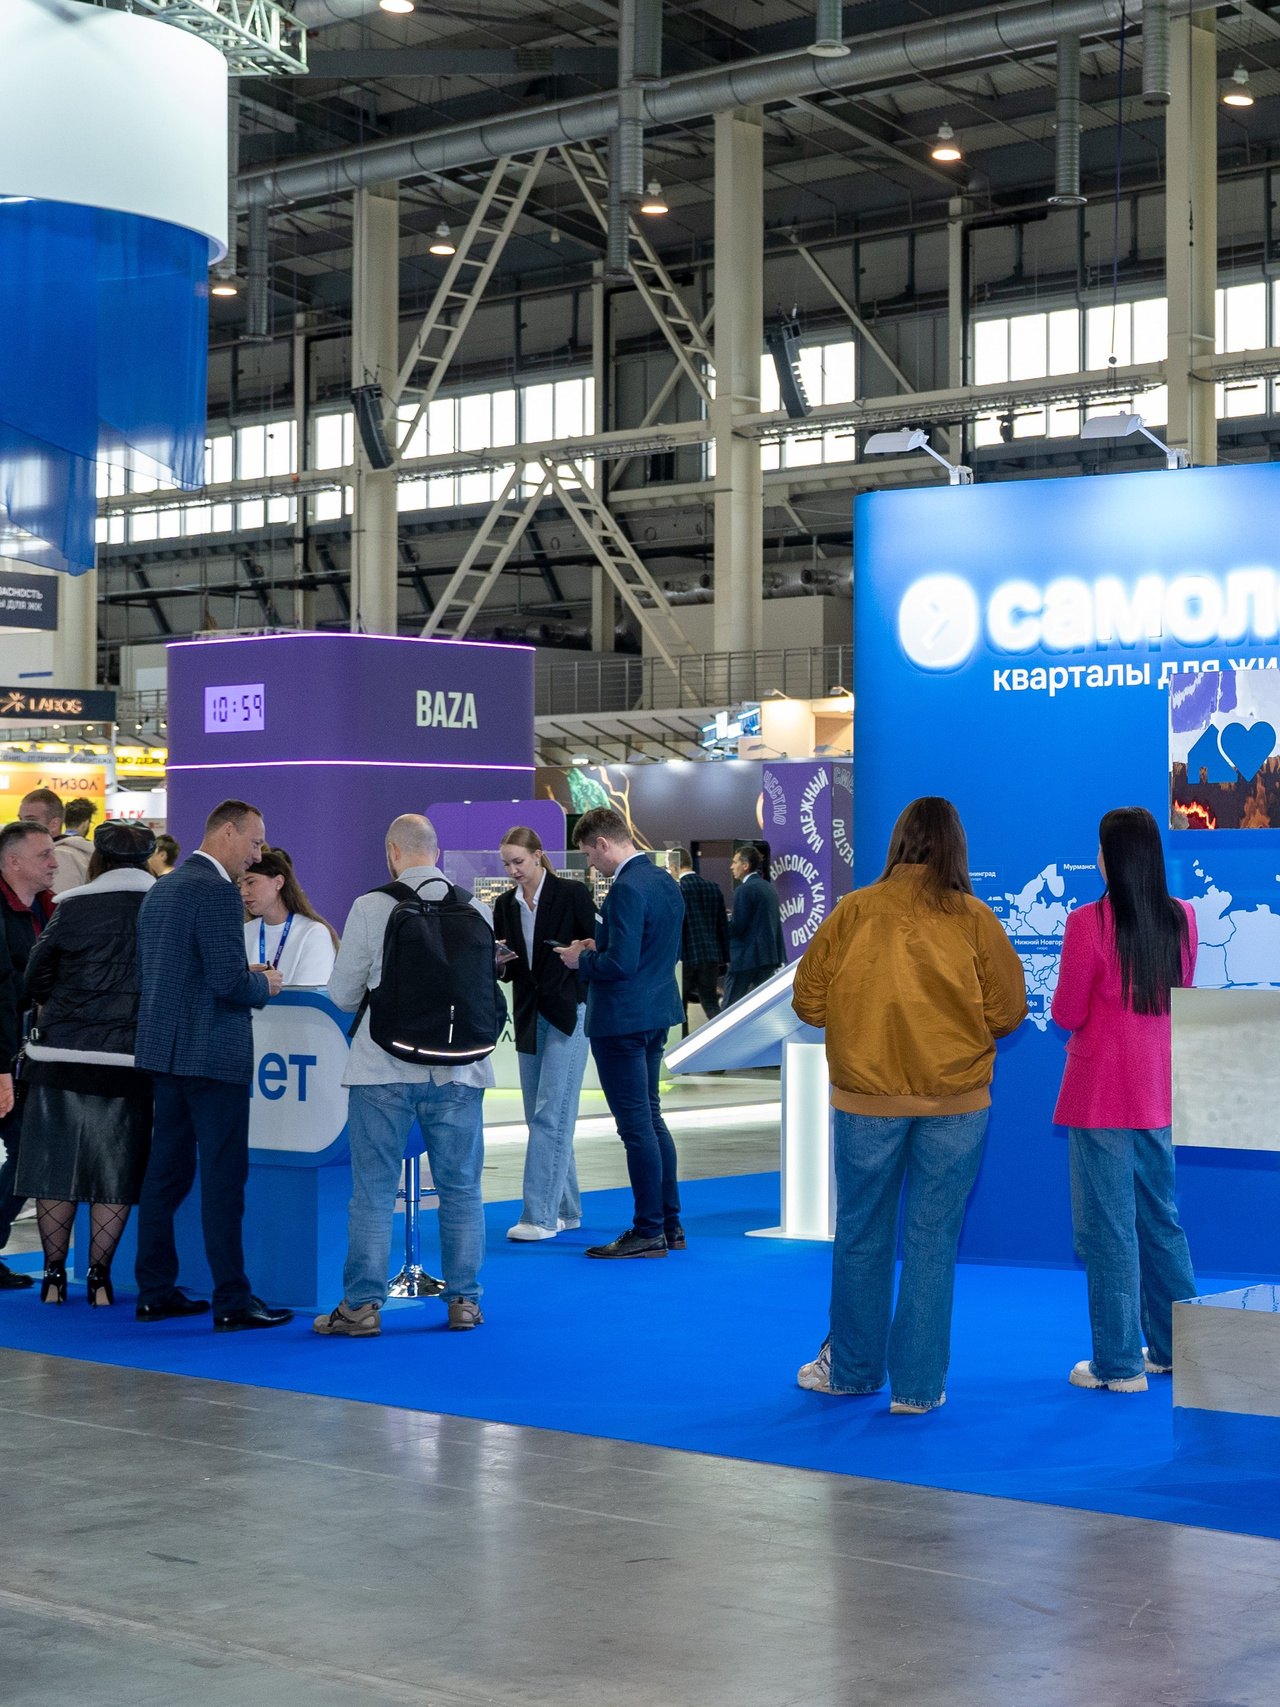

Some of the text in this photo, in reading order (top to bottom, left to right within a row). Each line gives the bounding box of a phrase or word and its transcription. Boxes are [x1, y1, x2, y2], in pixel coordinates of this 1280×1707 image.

[994, 663, 1149, 697] кварталы
[213, 694, 262, 722] 10:59
[416, 690, 478, 729] BAZA
[763, 770, 787, 826] ЧЕСТНО
[800, 767, 829, 854] НАДЕЖНЫЙ
[1063, 863, 1097, 871] Мурманск
[770, 854, 825, 947] ВЫСОКОЕ КАЧЕСТВО
[779, 893, 804, 923] НЫЙ
[1040, 939, 1064, 948] Новгор
[249, 1052, 317, 1102] ет
